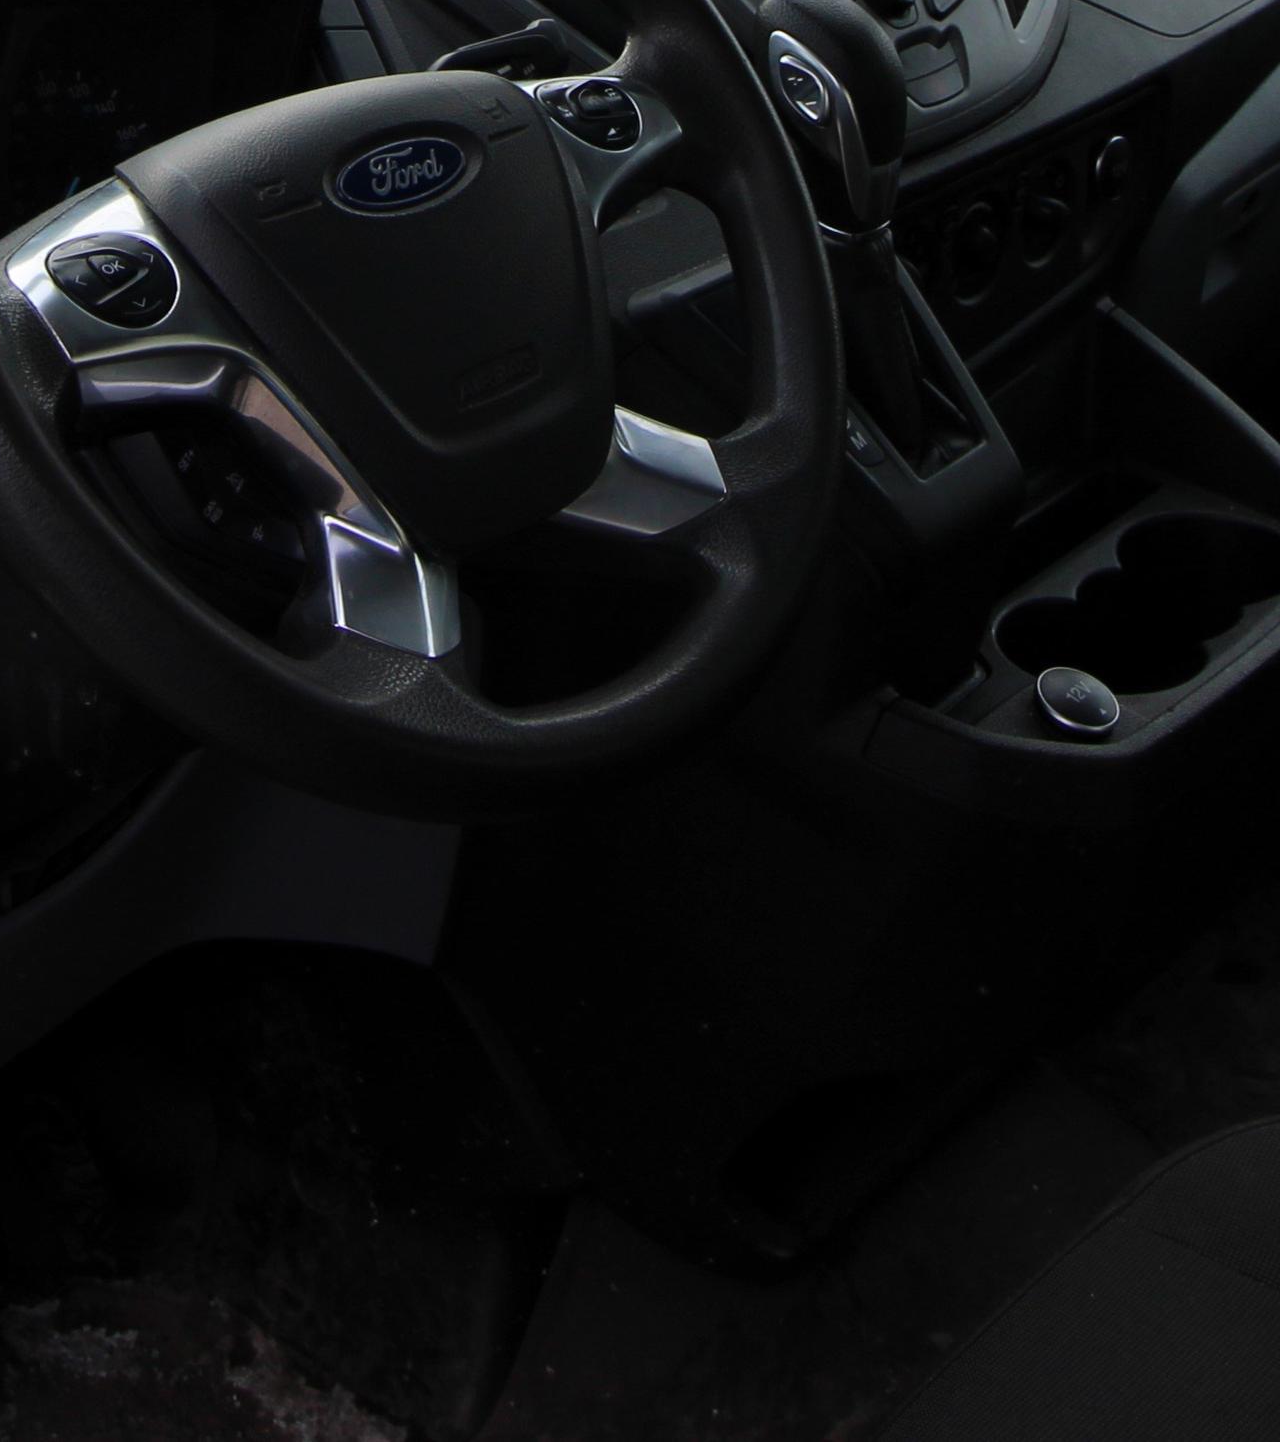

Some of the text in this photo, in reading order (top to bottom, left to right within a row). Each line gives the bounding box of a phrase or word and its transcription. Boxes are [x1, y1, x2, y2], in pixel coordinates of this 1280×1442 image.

[368, 146, 444, 197] Ford
[101, 259, 126, 275] OK
[1065, 680, 1091, 703] 12V
